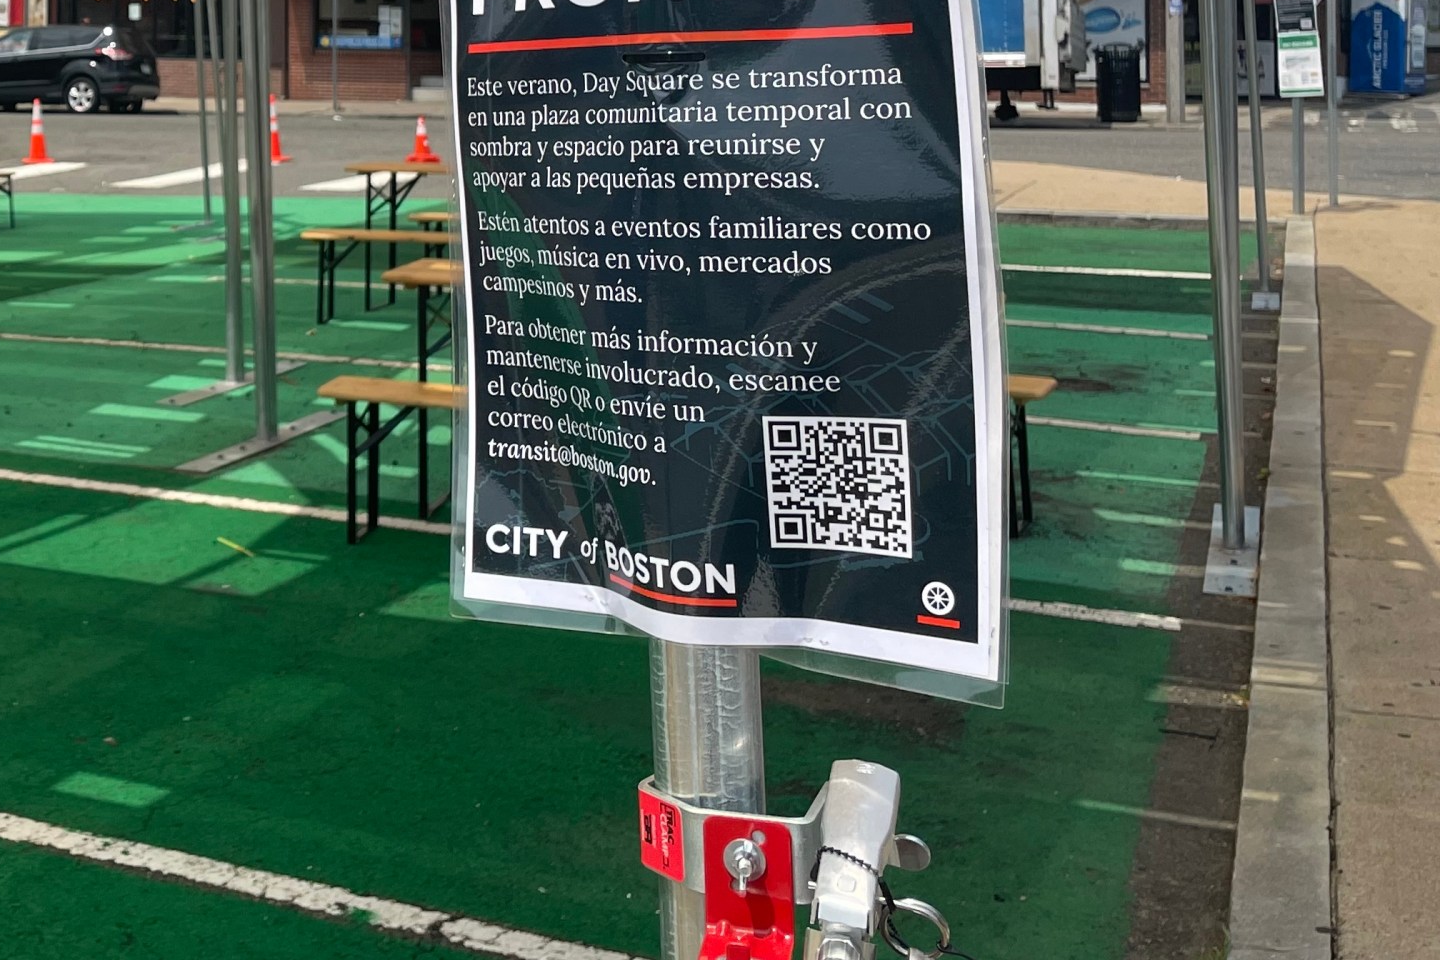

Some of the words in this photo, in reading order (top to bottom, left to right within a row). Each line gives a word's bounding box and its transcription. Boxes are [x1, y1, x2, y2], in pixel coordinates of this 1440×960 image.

[468, 77, 502, 96] Este
[507, 76, 576, 97] verano,
[583, 71, 620, 99] Day
[626, 69, 703, 99] Square
[712, 71, 739, 89] se
[748, 64, 902, 88] transforma
[468, 110, 487, 126] en
[493, 109, 525, 126] una
[531, 104, 579, 132] plaza
[585, 101, 718, 124] comunitaria
[726, 97, 851, 128] temporal
[860, 100, 912, 119] con
[470, 136, 532, 156] sombra
[537, 139, 548, 163] y
[553, 135, 624, 163] espacio
[630, 138, 680, 162] para
[688, 133, 800, 155] reunirse
[809, 137, 825, 161] y
[473, 170, 526, 193] apoyar
[531, 170, 541, 187] a
[547, 166, 571, 187] las
[577, 167, 675, 195] pequeñas
[684, 170, 819, 195] empresas.
[478, 211, 520, 232] Estén
[524, 215, 589, 235] atentos
[595, 220, 605, 236] a
[612, 219, 700, 238] eventos
[709, 216, 842, 239] familiares
[851, 221, 931, 240] como
[479, 241, 534, 268] juegos,
[537, 244, 599, 268] música
[605, 253, 630, 269] en
[636, 249, 690, 275] vivo,
[699, 250, 832, 276] mercados
[483, 275, 574, 299] campesinos
[579, 284, 590, 306] y
[595, 279, 642, 303] más.
[485, 315, 524, 336] Para
[528, 318, 586, 345] obtener
[591, 326, 630, 350] más
[637, 329, 793, 357] información
[801, 340, 817, 365] y
[486, 350, 582, 376] mantenerse
[585, 357, 720, 393] involucrado,
[729, 372, 840, 392] escanee
[488, 375, 505, 396] el
[511, 377, 567, 408] código
[570, 386, 592, 412] QR
[595, 396, 605, 411] o
[610, 395, 666, 419] envíe
[673, 403, 705, 422] un
[488, 411, 553, 431] correo
[558, 414, 647, 450] electrónico
[654, 436, 667, 453] a
[488, 438, 656, 488] transit@boston.gov.
[486, 524, 568, 559] CITY
[580, 537, 598, 564] of
[605, 540, 736, 593] BOSTON
